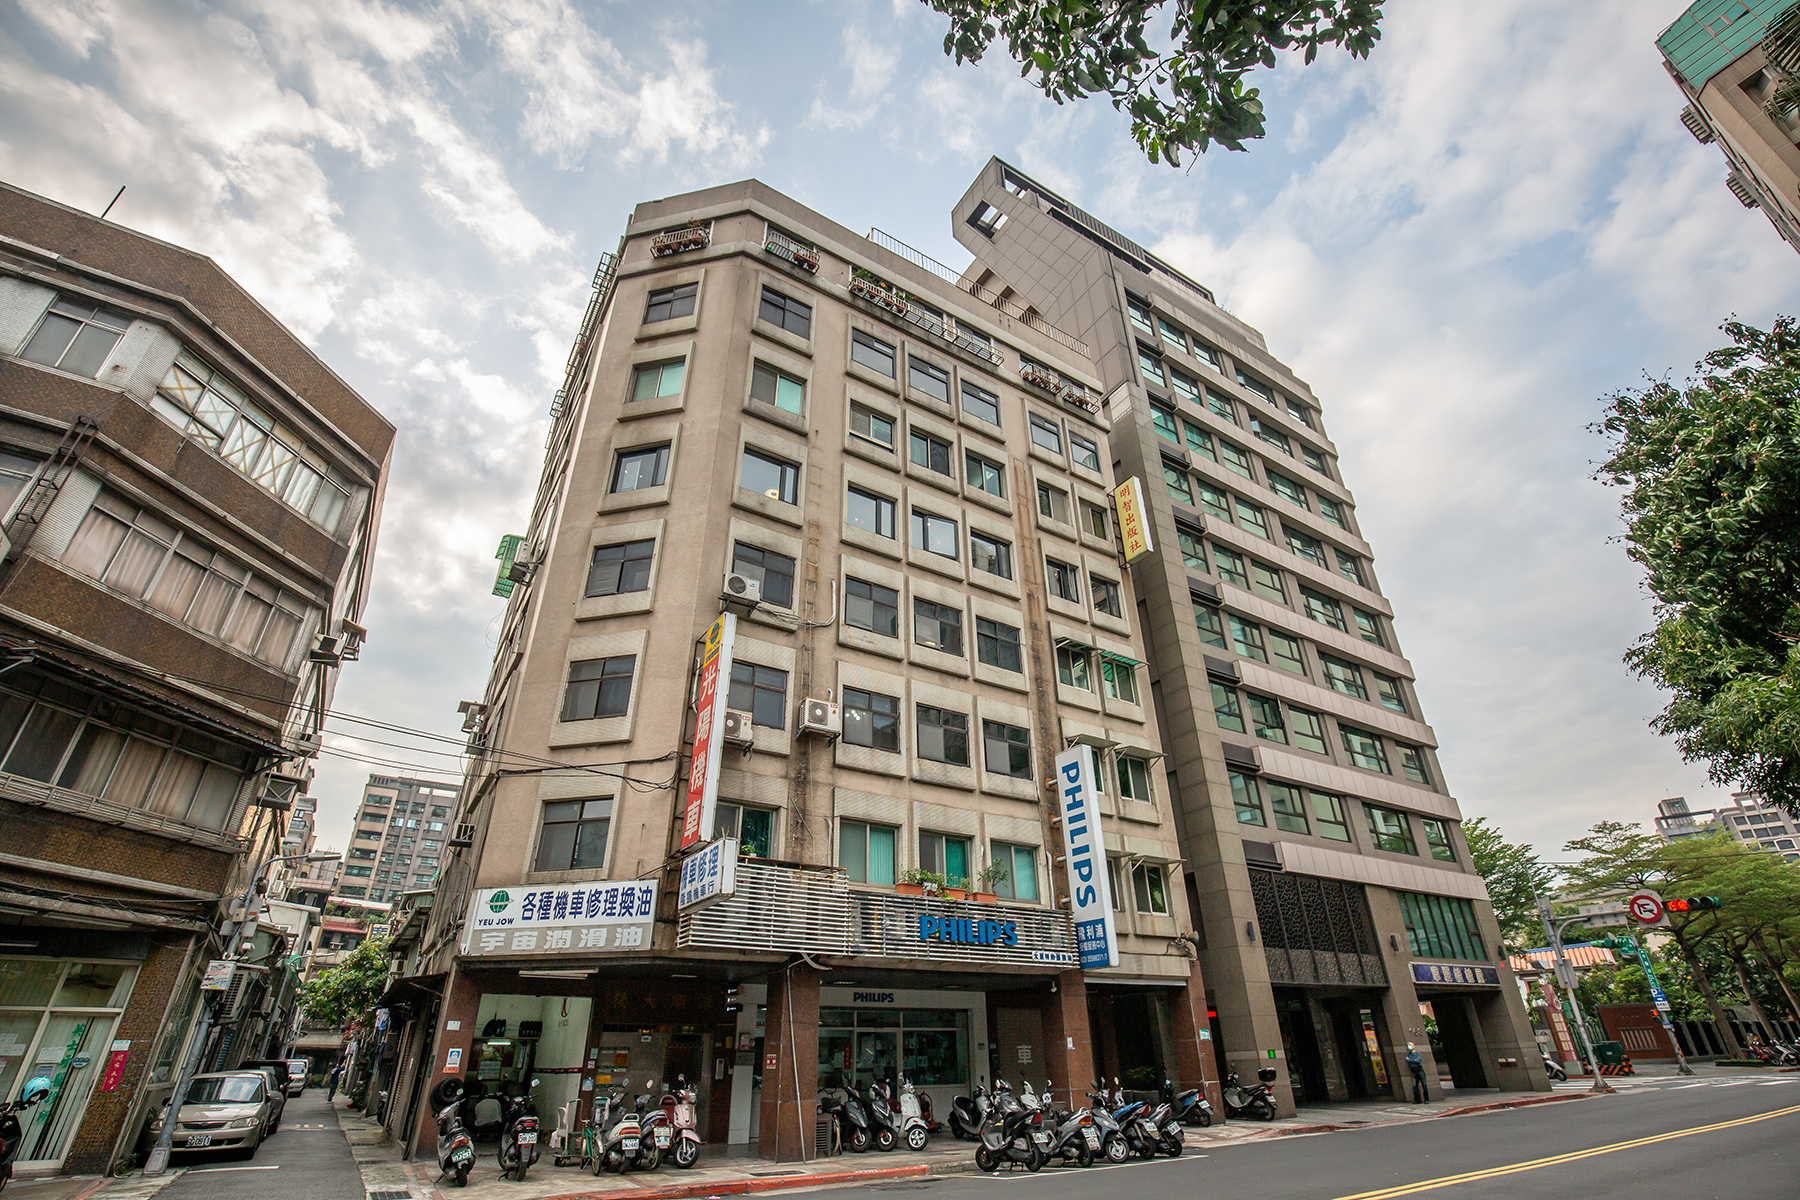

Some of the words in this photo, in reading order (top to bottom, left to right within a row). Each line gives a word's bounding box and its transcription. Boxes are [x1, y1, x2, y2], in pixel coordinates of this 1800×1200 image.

[1119, 484, 1142, 554] 明智出版社
[684, 664, 716, 840] 光陽機車
[1061, 760, 1097, 908] PHILIPS
[521, 885, 653, 922] 各種機車修理換油
[496, 917, 515, 925] JOW
[919, 915, 1018, 946] PHILIPS
[1077, 923, 1104, 940] 飛利浦
[479, 926, 644, 951] 宇宙潤滑油
[853, 991, 894, 1003] PHILIPS
[1017, 1044, 1033, 1065] 車
